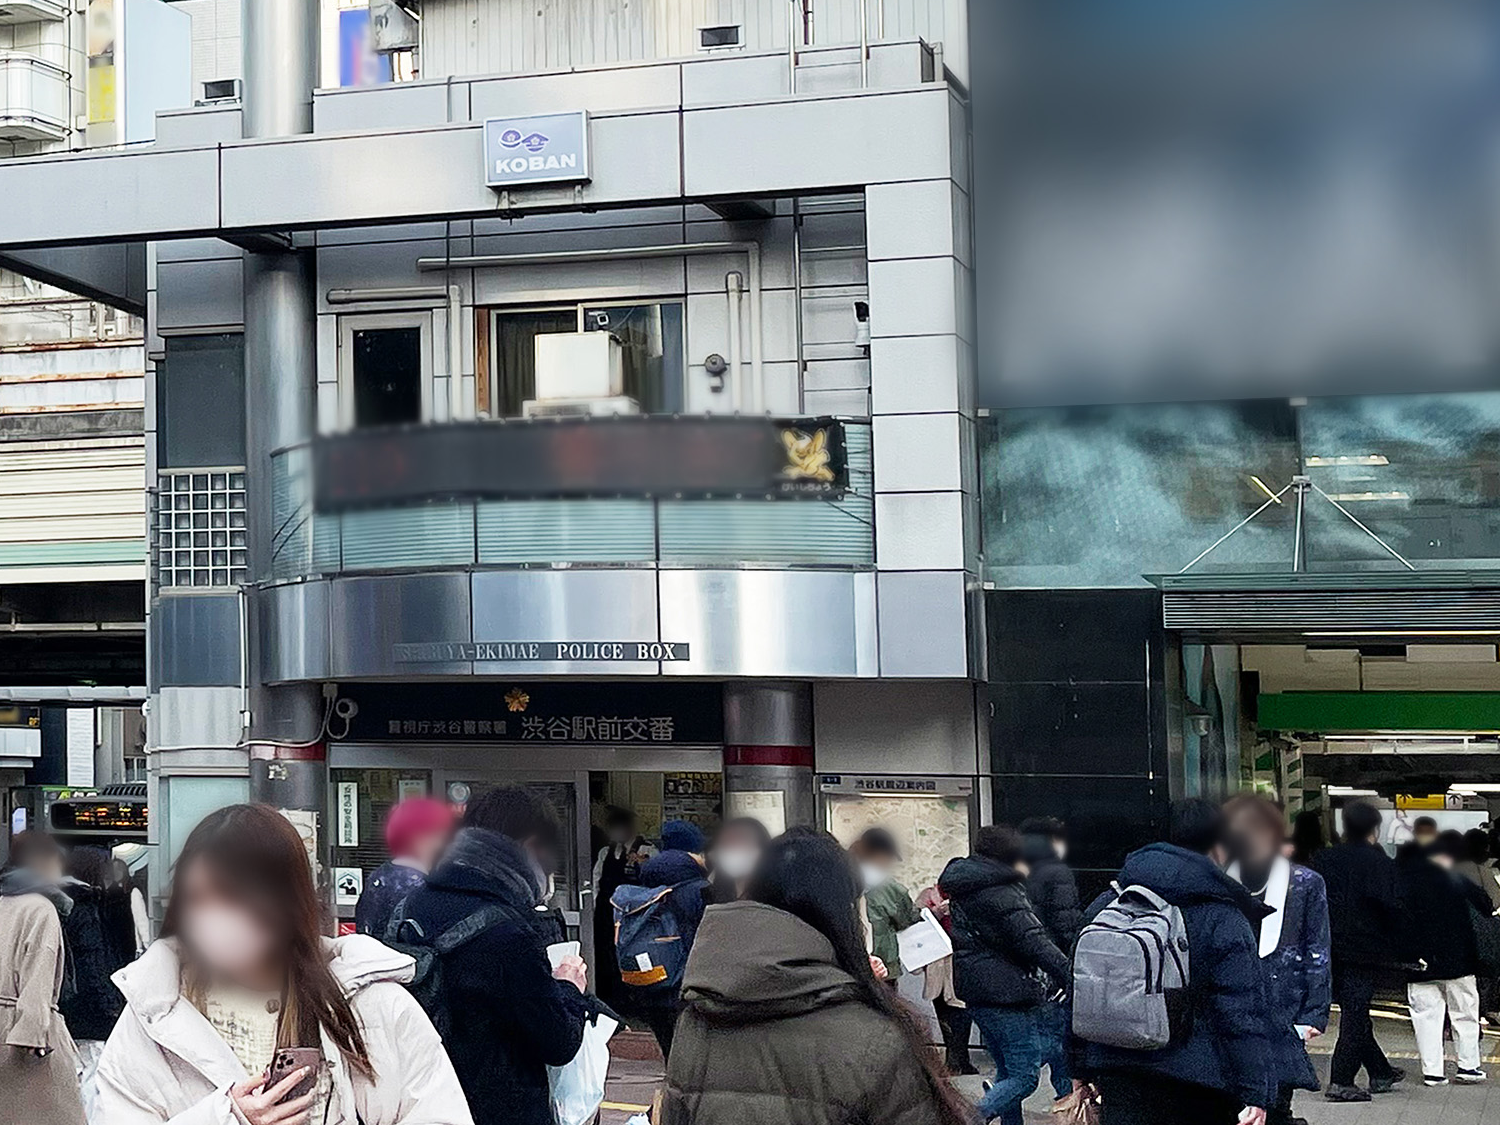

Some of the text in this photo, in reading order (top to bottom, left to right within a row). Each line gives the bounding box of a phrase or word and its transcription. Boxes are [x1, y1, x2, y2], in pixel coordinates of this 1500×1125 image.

[495, 154, 576, 174] KOBAN
[401, 642, 677, 661] SBUYA-EKIMAE POLICE BOX
[520, 716, 674, 741] 渋谷駅前交番
